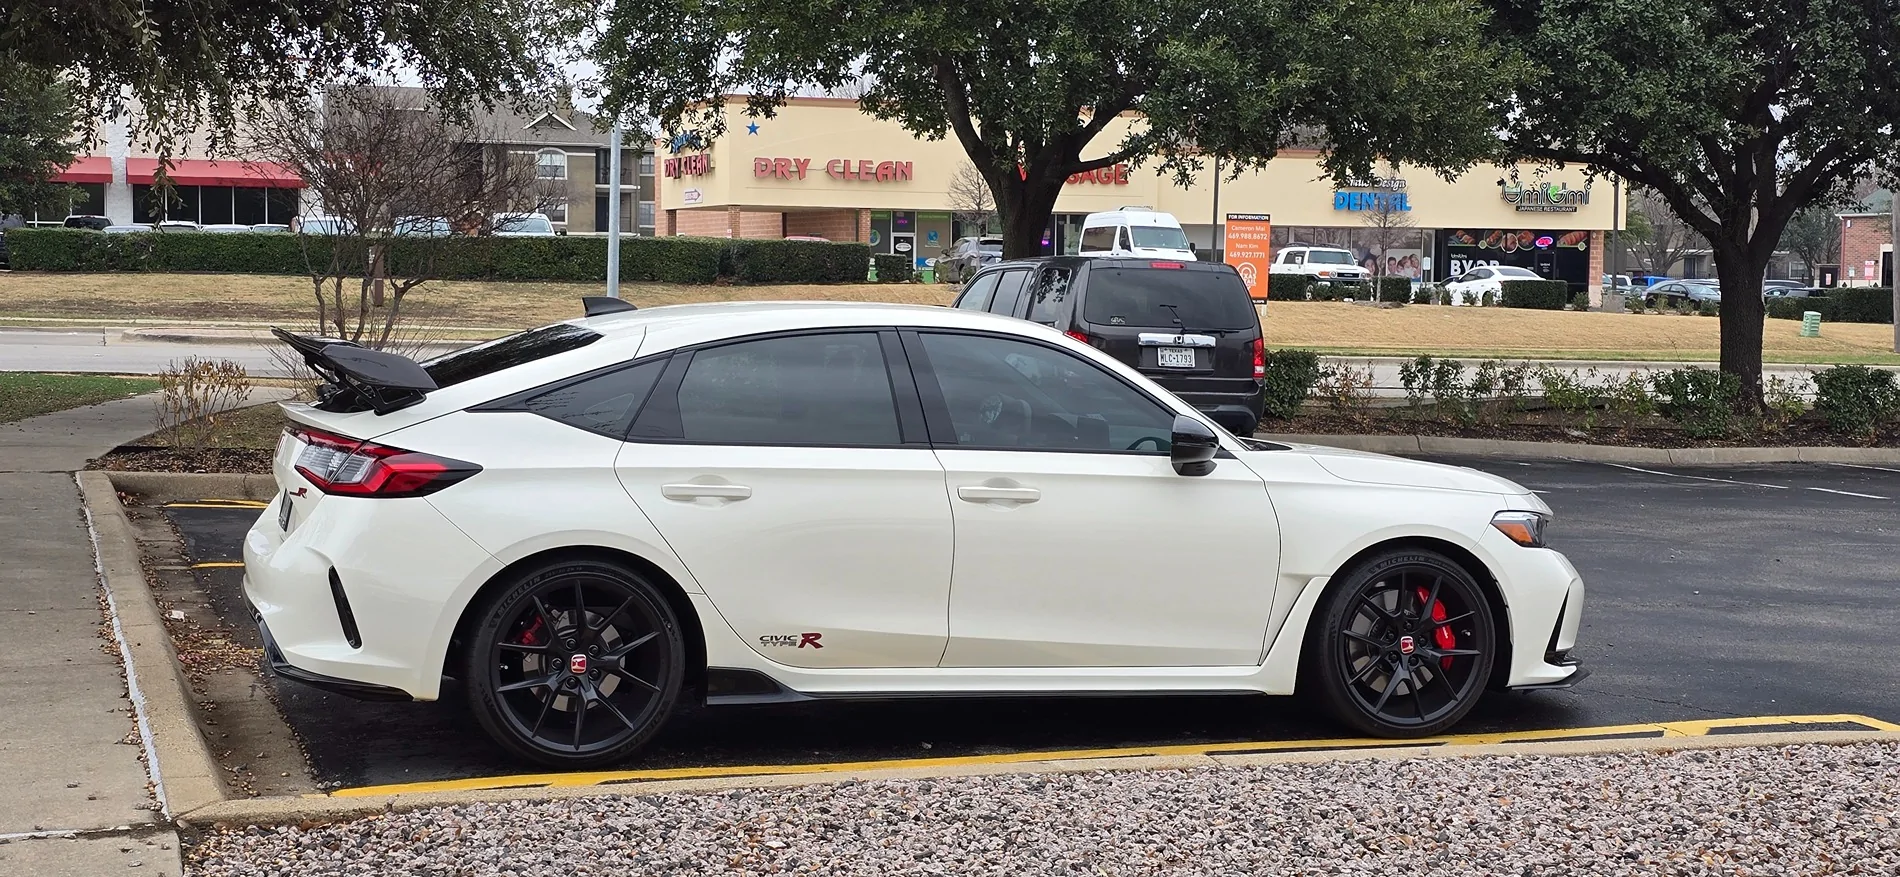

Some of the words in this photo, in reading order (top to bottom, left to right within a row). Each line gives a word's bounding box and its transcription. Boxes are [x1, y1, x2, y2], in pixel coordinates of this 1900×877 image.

[664, 157, 681, 179] DRY
[682, 153, 711, 176] CLEAN
[754, 157, 811, 181] DRY
[825, 158, 913, 182] CLEAN
[1334, 191, 1412, 212] DENTAL
[1380, 556, 1425, 568] MICHELIN
[497, 575, 541, 617] MICHELIN
[798, 632, 824, 649] R
